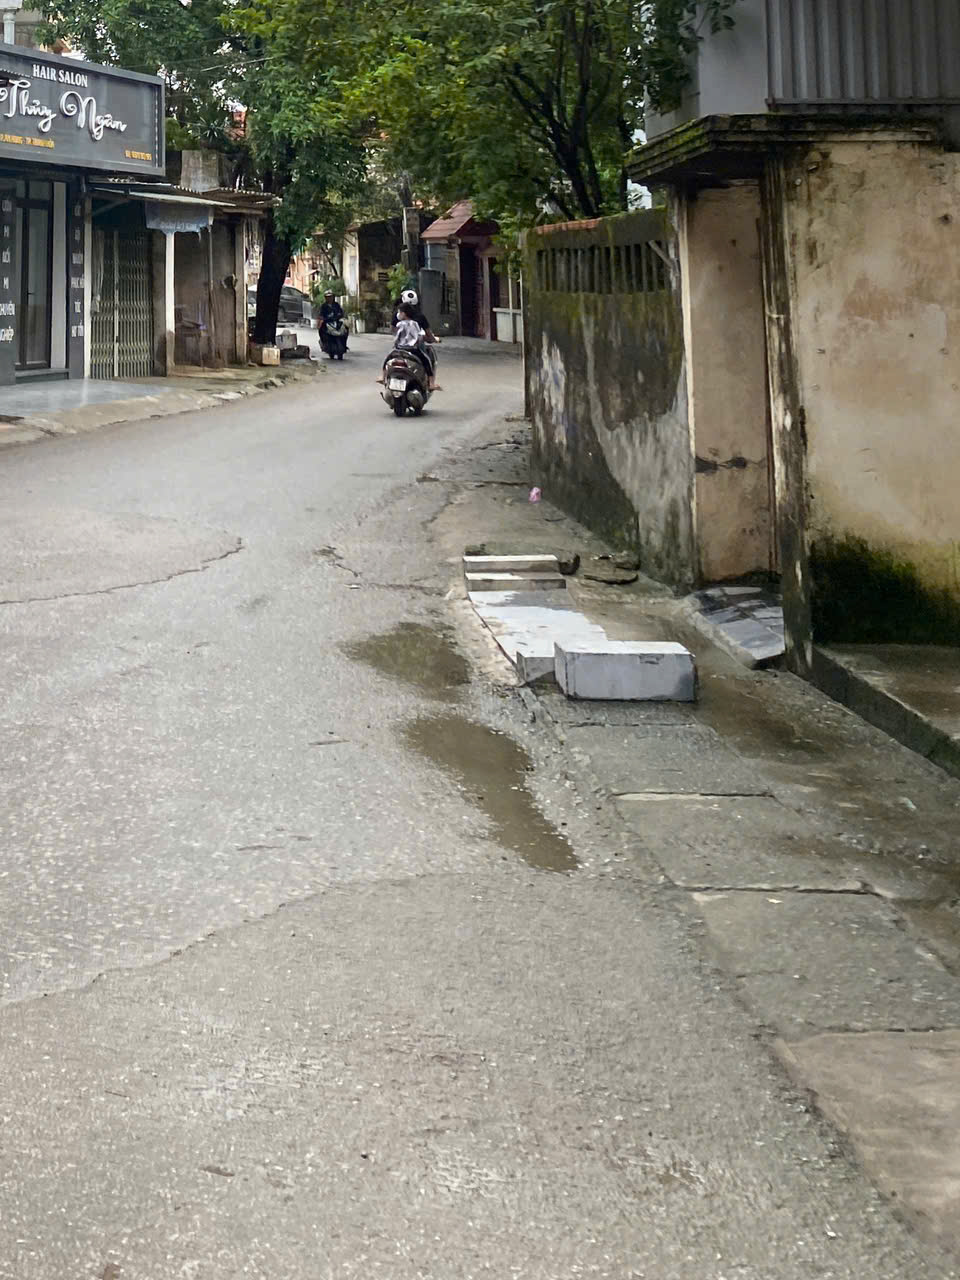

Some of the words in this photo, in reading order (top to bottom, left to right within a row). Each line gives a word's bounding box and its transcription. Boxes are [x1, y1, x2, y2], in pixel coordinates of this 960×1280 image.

[32, 64, 57, 81] HAIR
[58, 69, 88, 87] SALON
[60, 91, 127, 141] Ngân
